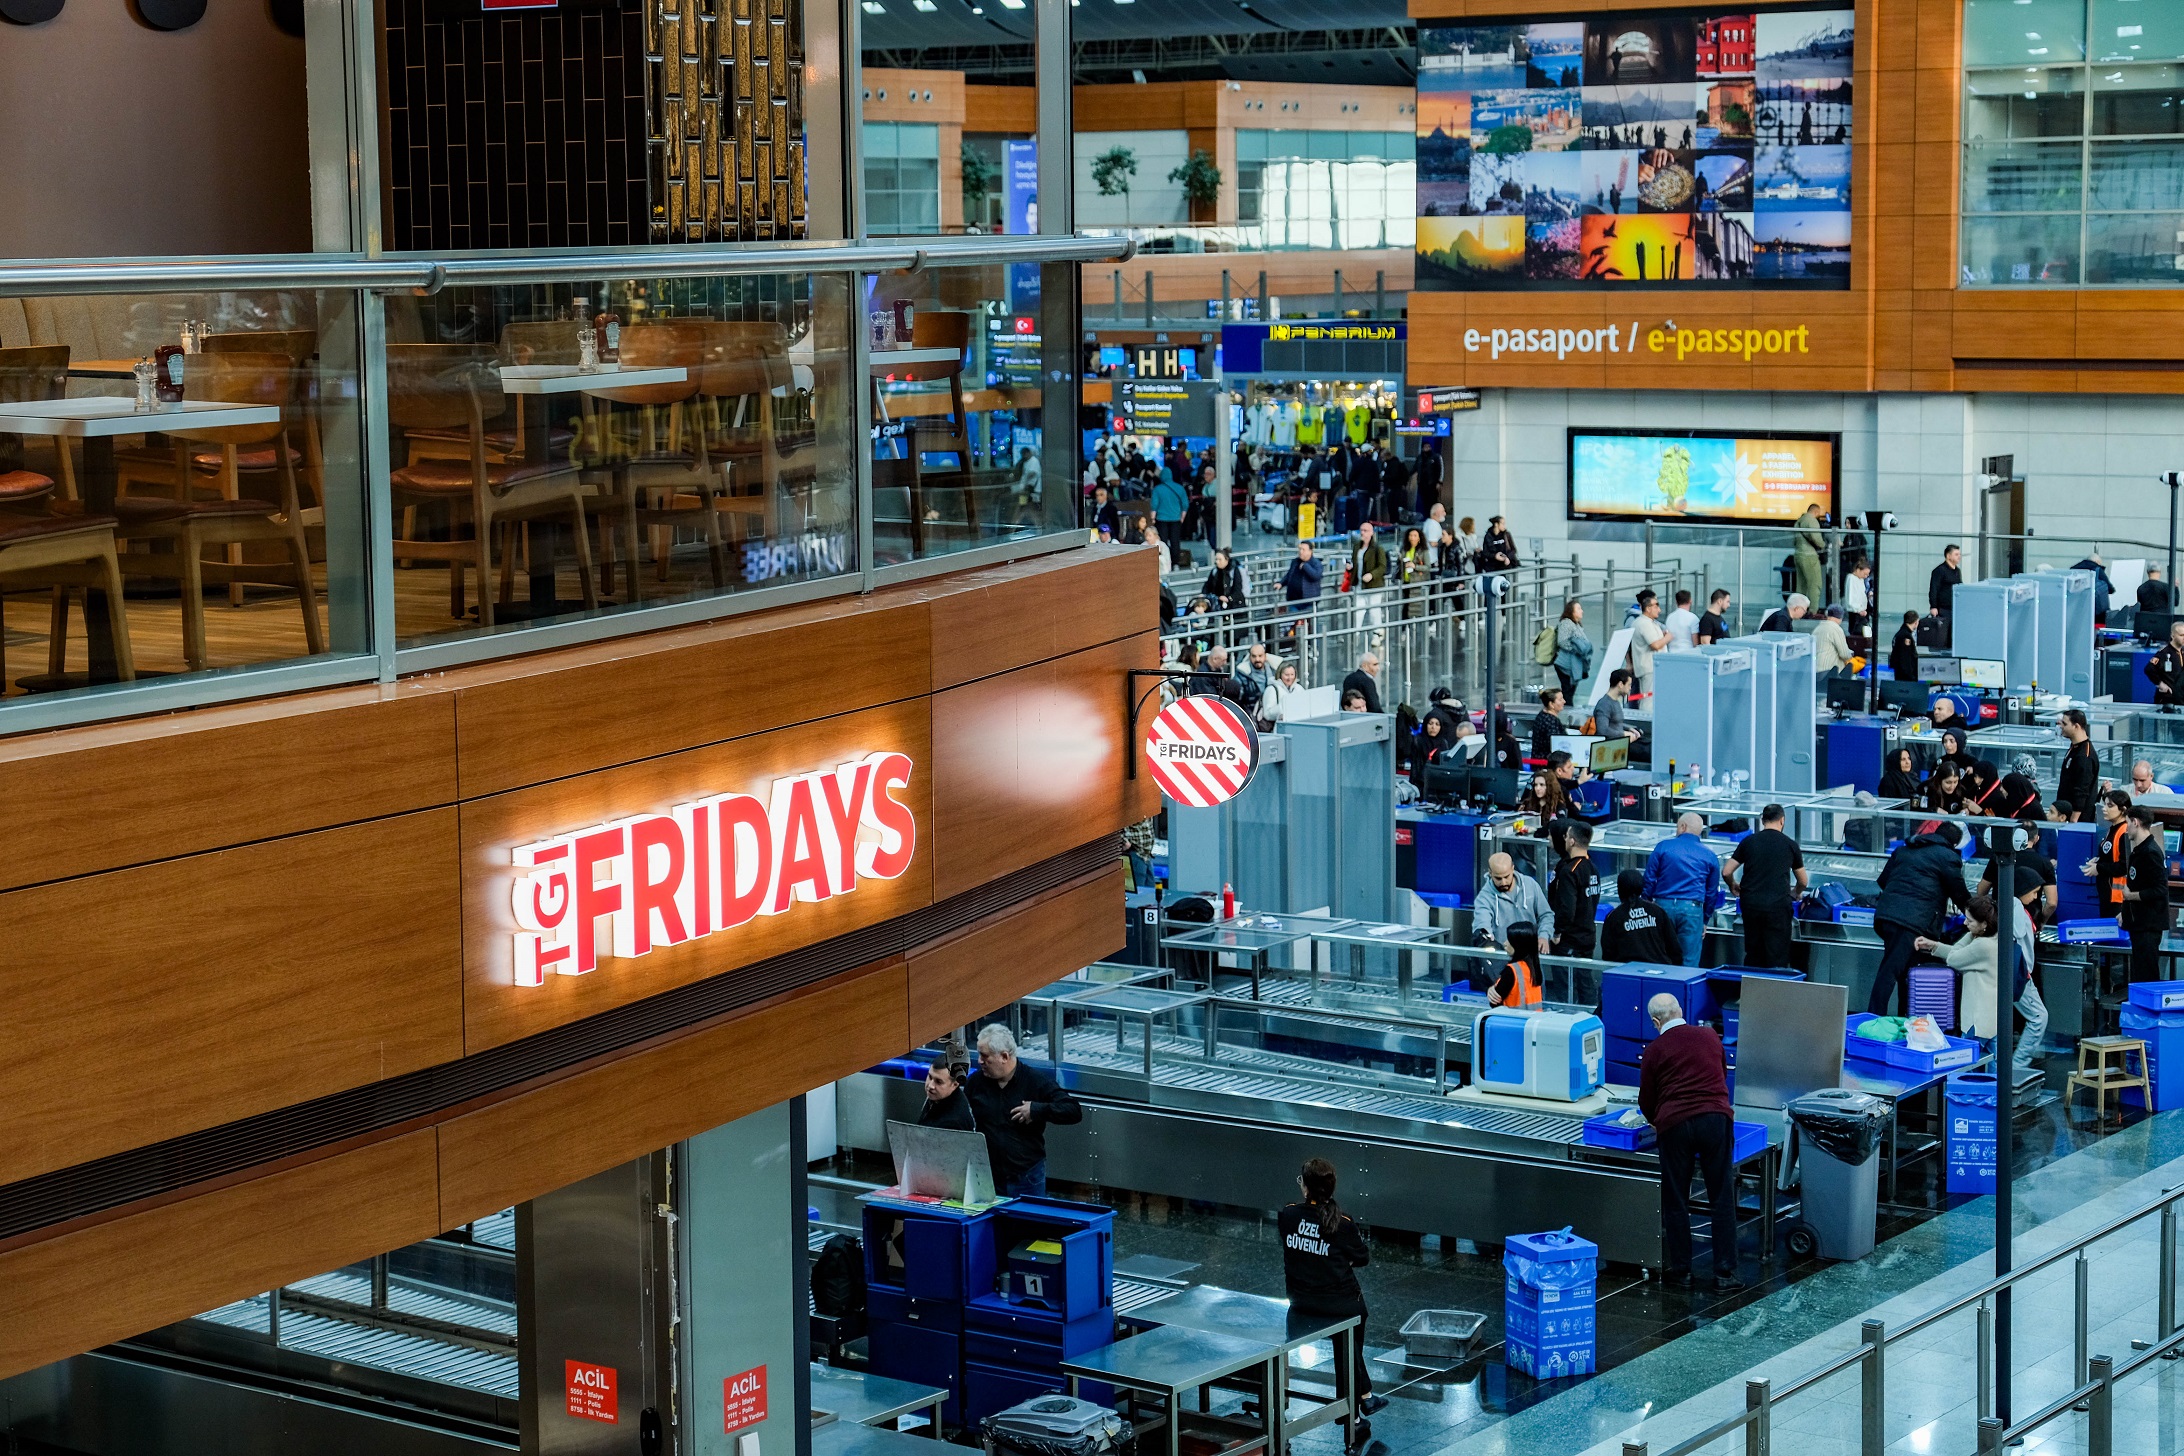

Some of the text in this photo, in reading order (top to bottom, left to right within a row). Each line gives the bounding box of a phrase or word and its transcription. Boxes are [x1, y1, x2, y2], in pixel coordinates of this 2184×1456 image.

[1463, 322, 1809, 361] e-pasaport / e-passport
[1138, 349, 1157, 377] H
[1164, 349, 1178, 376] H
[1889, 730, 1895, 738] 5
[1160, 743, 1236, 761] TGI FRIDAYS
[1651, 789, 1658, 798] 6
[1482, 828, 1489, 838] 7
[573, 753, 916, 977] FRIDAYS
[1147, 911, 1155, 922] 8
[1624, 914, 1657, 931] GÜVENLİK
[1629, 907, 1648, 919] ÖZEL
[1298, 1218, 1320, 1238] ÖZEL
[1286, 1232, 1330, 1257] GÜVENLİK
[1030, 1278, 1038, 1293] 1
[573, 1368, 610, 1390] ACİL
[730, 1372, 761, 1399] ACİL
